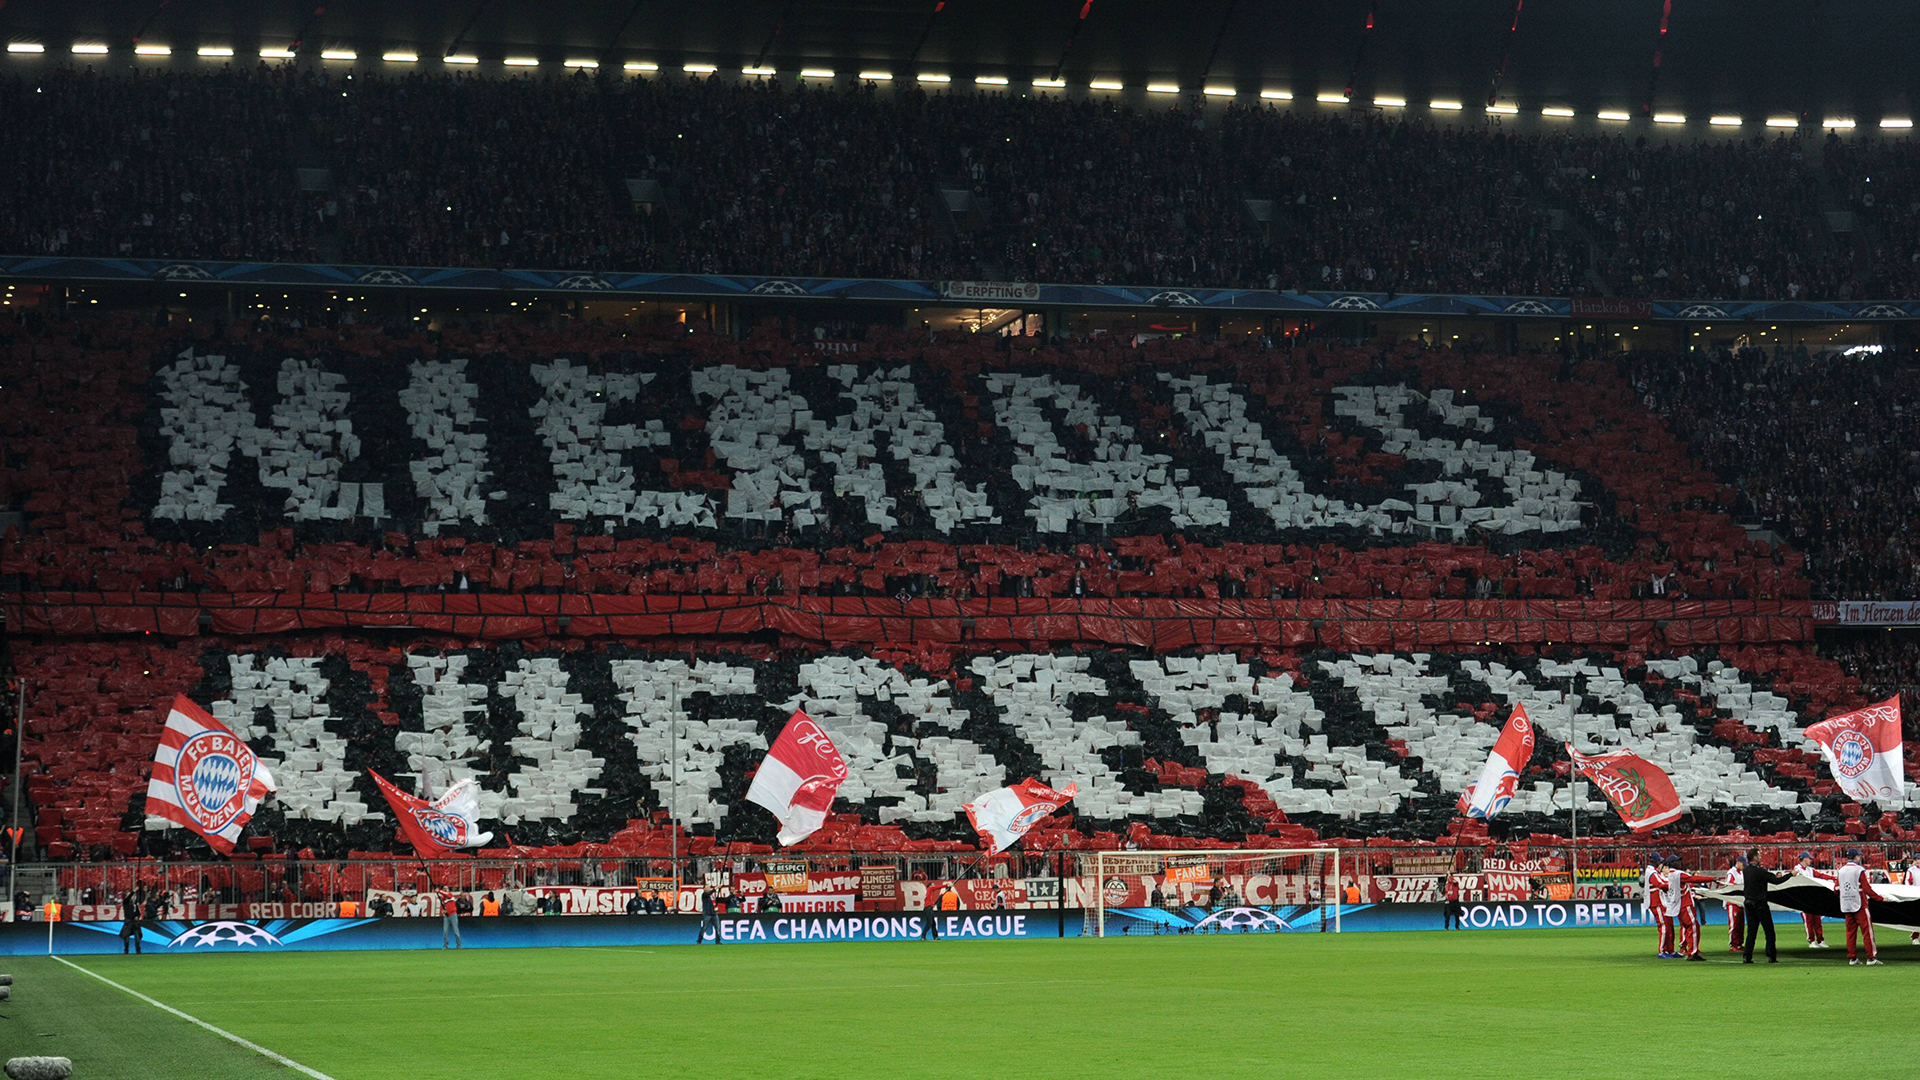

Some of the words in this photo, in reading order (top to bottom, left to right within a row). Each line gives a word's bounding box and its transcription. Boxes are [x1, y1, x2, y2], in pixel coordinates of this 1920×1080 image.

[1190, 94, 1207, 105] 314
[1484, 115, 1502, 126] 313
[966, 286, 1023, 298] ERPFTING
[1572, 299, 1629, 314] Hatzkofa
[153, 347, 1585, 535] NIEMALS
[1844, 603, 1860, 622] Im
[1862, 603, 1904, 622] Herzen
[187, 740, 209, 762] FC
[212, 736, 251, 791] BAYERN
[777, 863, 806, 871] RESPECT
[1118, 865, 1135, 874] BEI
[1136, 864, 1157, 874] UNS
[1483, 858, 1506, 870] RED
[861, 875, 895, 884] JUNGS!
[1175, 864, 1207, 881] FANS!
[649, 882, 675, 890] RESPEC
[740, 879, 767, 893] RED
[773, 872, 807, 889] FANS!
[973, 879, 1014, 889] ULTRAS
[1141, 875, 1371, 907] MNCHEN
[250, 902, 285, 918] RED
[1533, 903, 1567, 926] TO
[773, 917, 922, 940] CHAMPIONS
[937, 915, 1027, 938] LEAGUE
